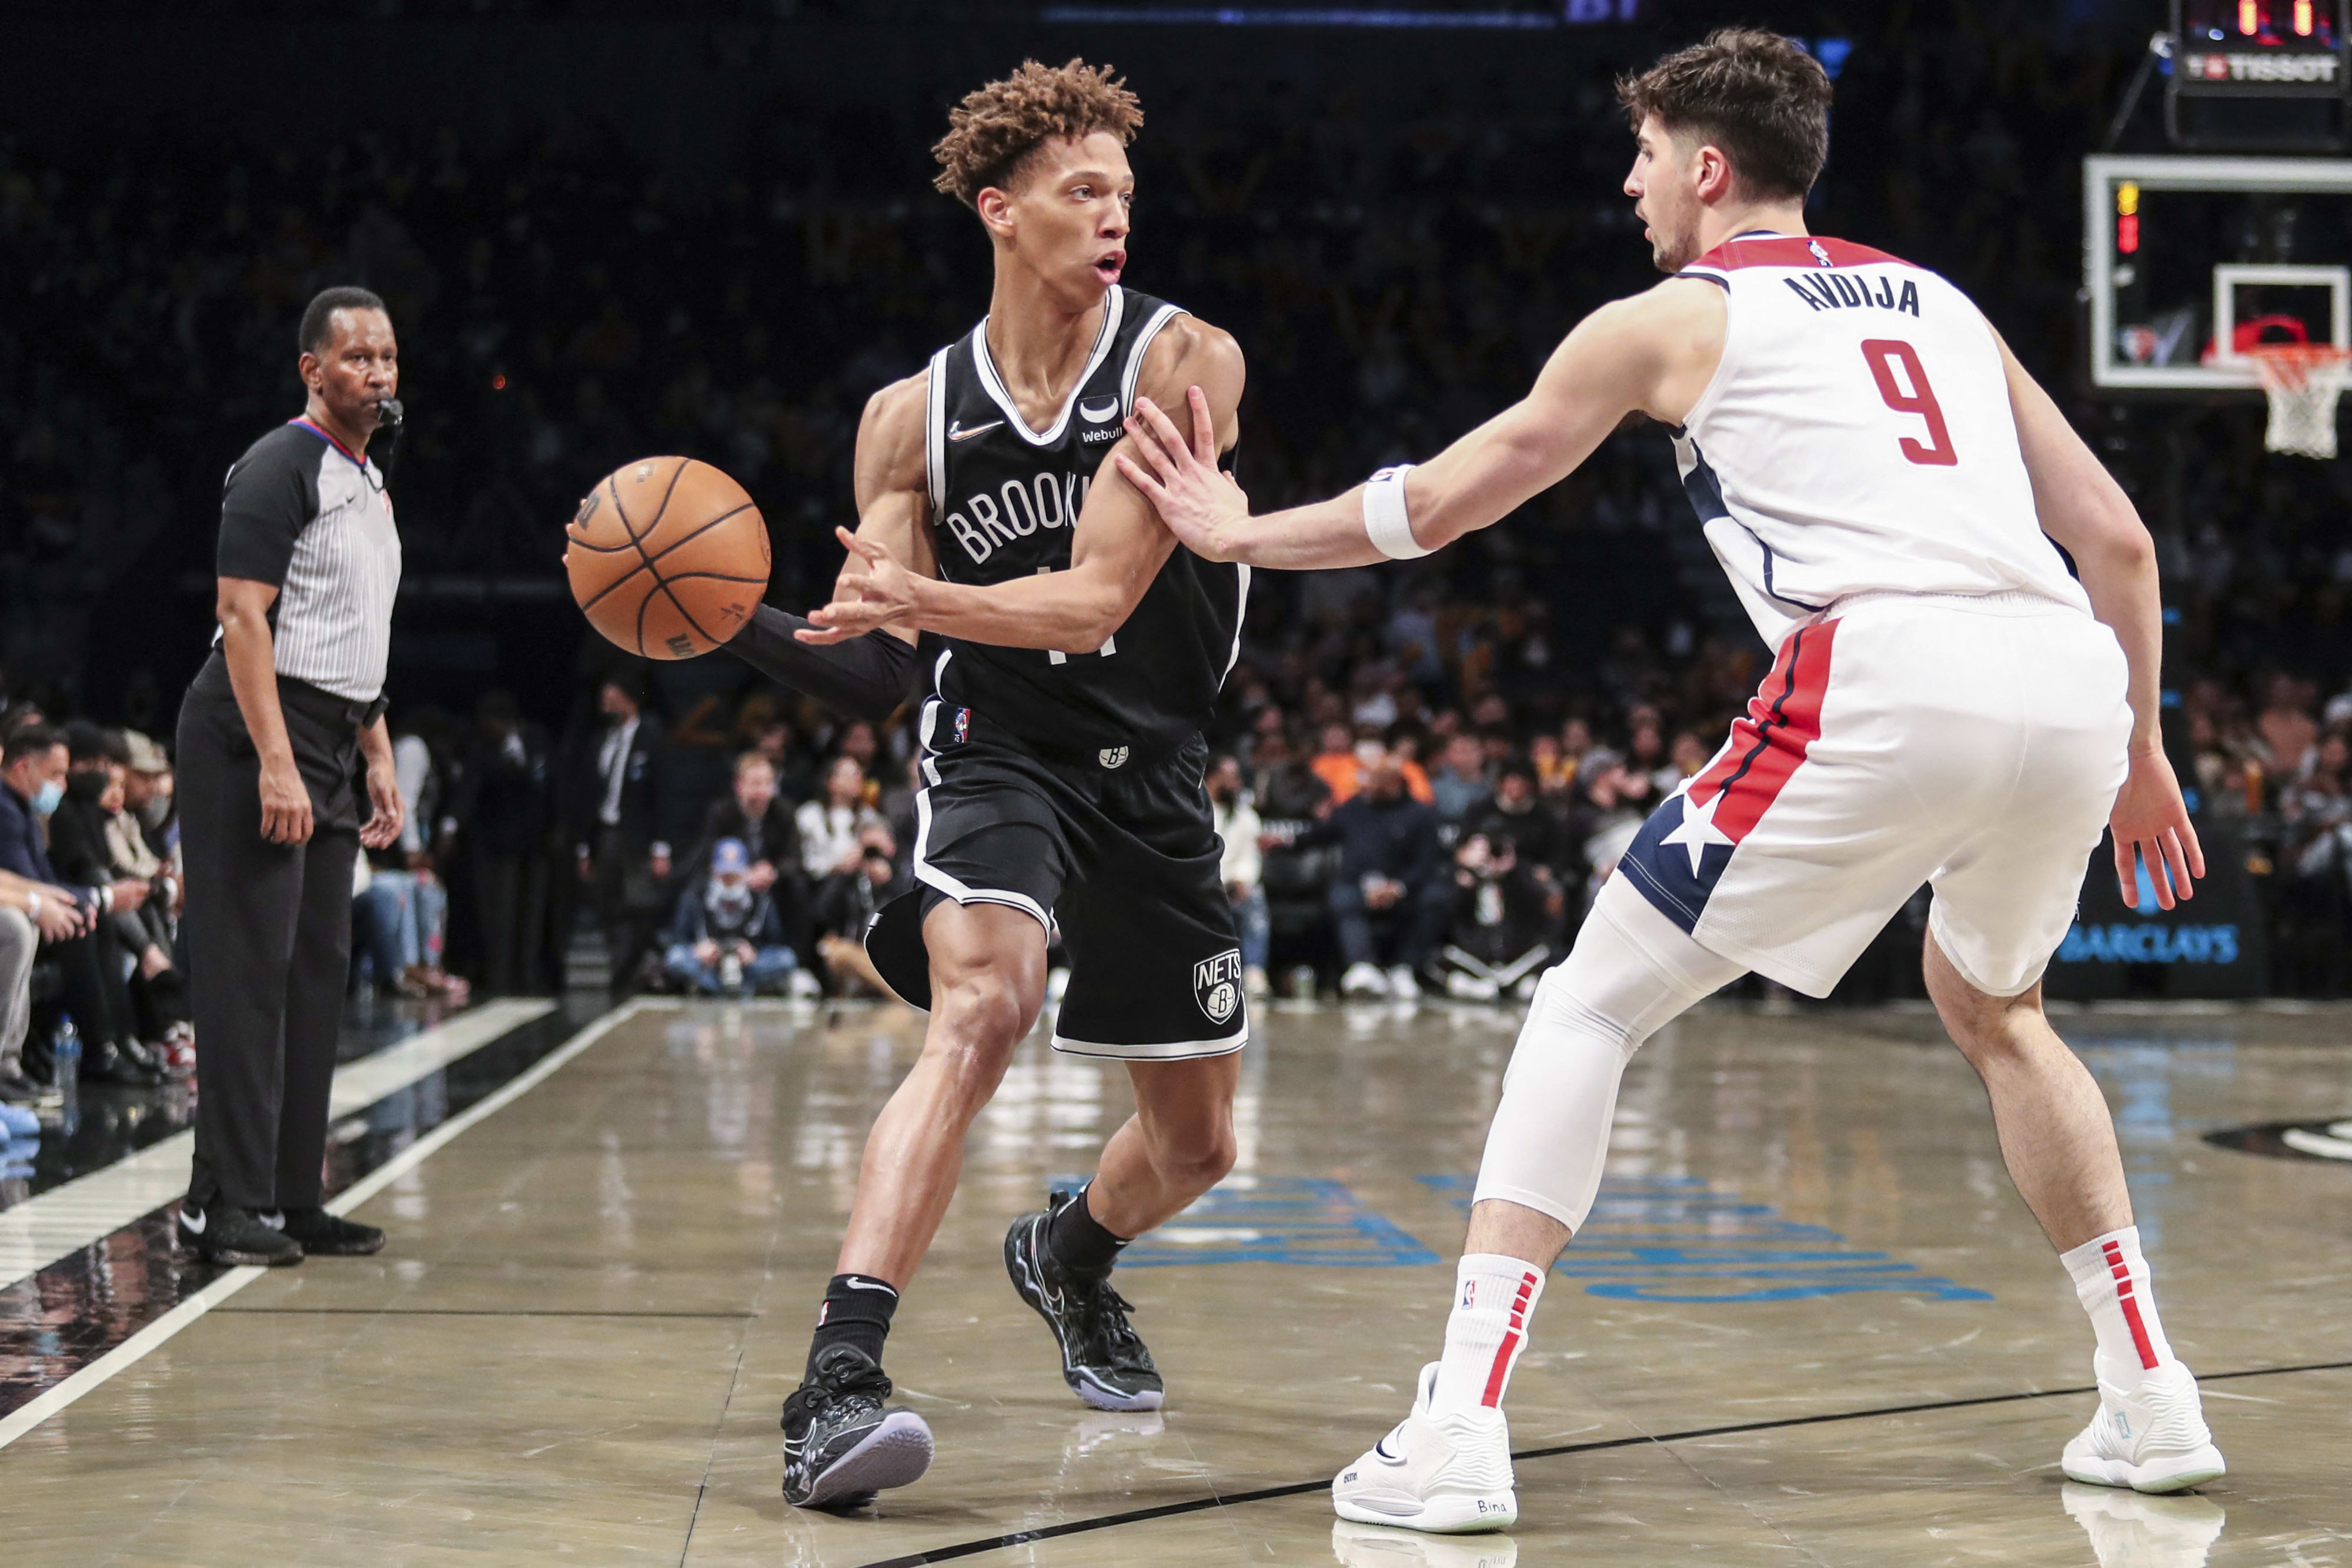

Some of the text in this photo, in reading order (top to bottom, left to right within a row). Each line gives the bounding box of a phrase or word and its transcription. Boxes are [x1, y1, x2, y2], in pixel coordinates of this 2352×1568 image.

[2229, 53, 2339, 81] TISSOT
[1783, 272, 1920, 318] AVDIJA
[1860, 339, 1958, 466] 9
[1083, 427, 1122, 443] Webull
[1198, 952, 1241, 990] NETS
[1477, 1500, 1508, 1513] Bina
